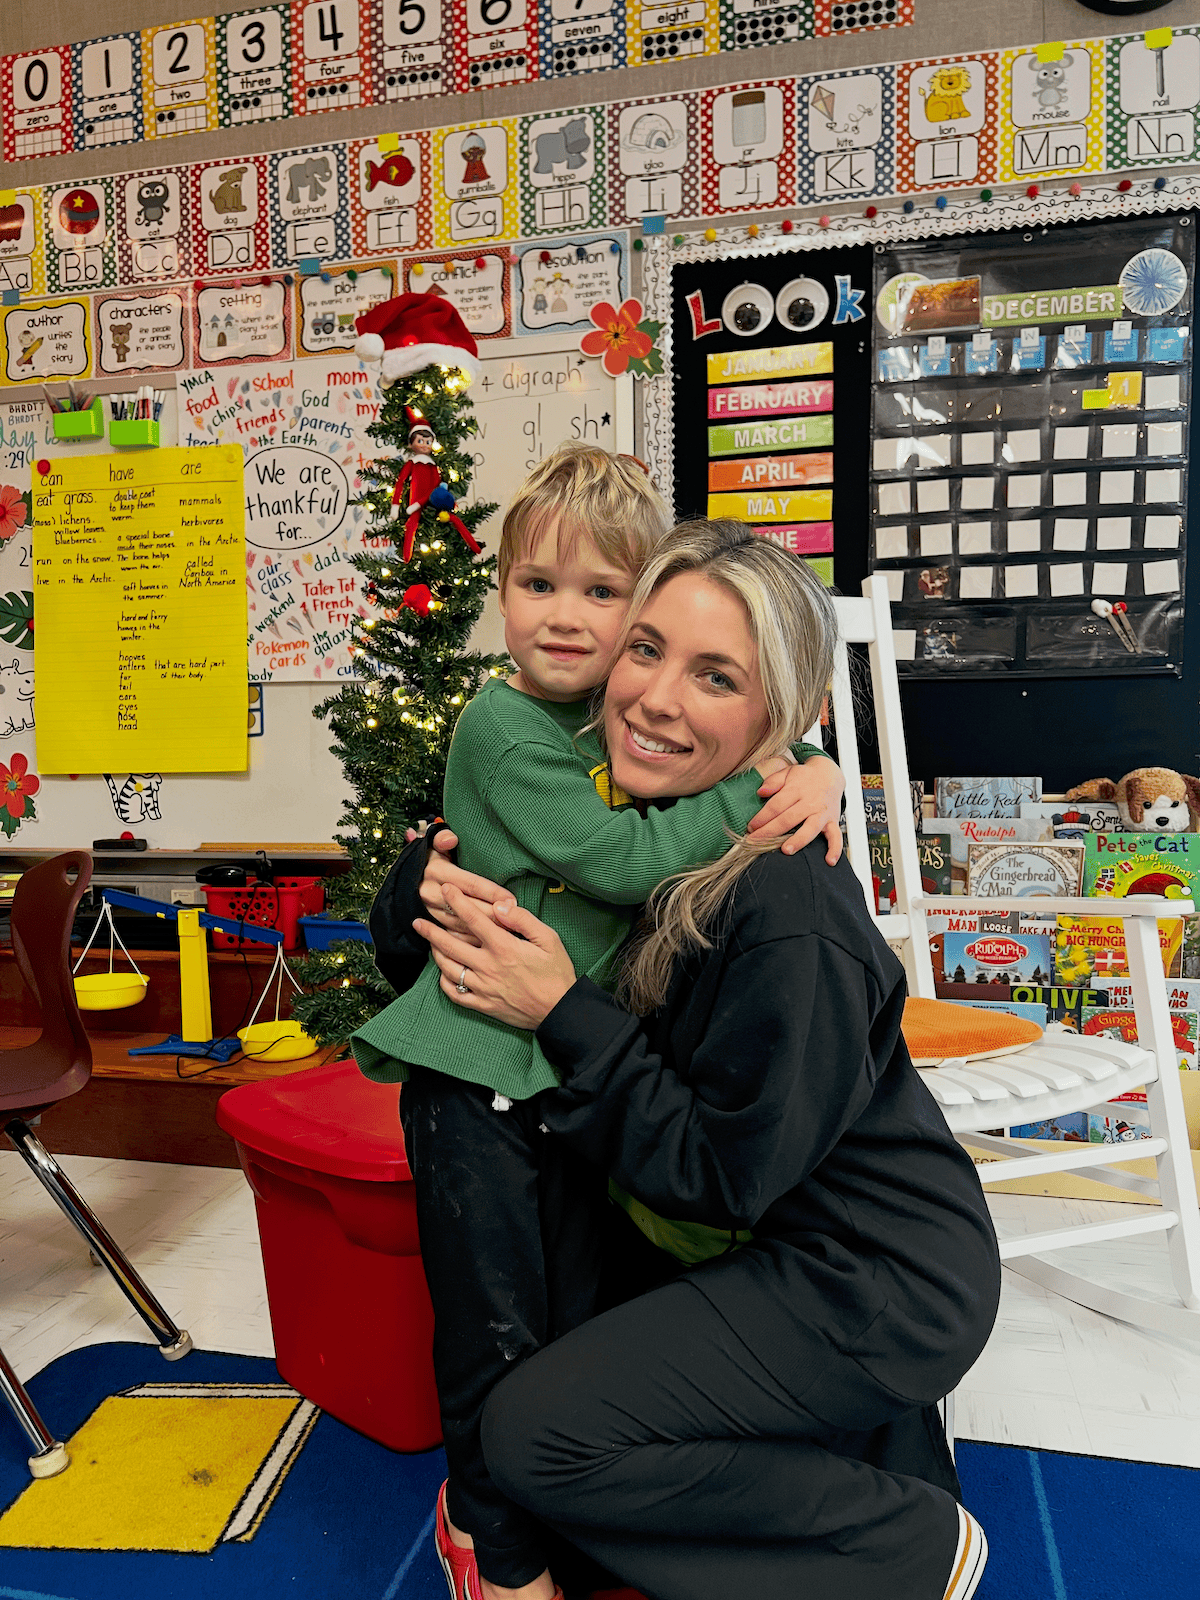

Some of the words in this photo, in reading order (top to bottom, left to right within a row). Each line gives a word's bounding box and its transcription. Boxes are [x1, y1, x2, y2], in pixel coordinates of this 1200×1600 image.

[398, 0, 425, 35] 5
[657, 8, 691, 26] eight
[318, 5, 344, 52] 4
[565, 25, 601, 38] seven
[241, 21, 266, 63] 3
[489, 39, 505, 50] six
[166, 32, 190, 73] 2
[401, 51, 425, 64] five
[104, 49, 111, 88] 1
[320, 63, 345, 76] four
[24, 59, 48, 101] 0
[240, 75, 272, 87] three
[170, 88, 191, 100] two
[1152, 95, 1170, 107] nail
[99, 102, 117, 113] one
[1032, 110, 1070, 120] mouse
[26, 112, 49, 126] zero
[939, 125, 956, 135] lion
[1137, 119, 1185, 155] Nn
[836, 138, 854, 148] kite
[1020, 132, 1082, 170] Mm
[552, 172, 576, 183] hippo
[824, 154, 866, 191] Kk
[457, 183, 496, 196] gumballs
[735, 165, 761, 205] Jj
[384, 196, 399, 205] fish
[641, 179, 666, 213] Ii
[291, 203, 327, 217] elephant
[542, 190, 585, 225] Hh
[223, 215, 238, 226] dog
[456, 200, 497, 236] Gg
[148, 228, 161, 237] cat
[377, 212, 405, 246] Ff
[294, 223, 329, 258] Ee
[211, 234, 251, 266] Dd
[135, 244, 174, 273] Cc
[65, 253, 98, 283] Bb
[334, 281, 357, 296] plot
[220, 293, 262, 307] setting
[991, 292, 1115, 321] DECEMBER
[110, 304, 172, 320] characters
[27, 315, 63, 328] author
[48, 331, 72, 340] writes
[51, 355, 73, 364] story
[721, 352, 817, 376] JANUARY
[180, 370, 214, 394] YMCA
[252, 369, 294, 392] school
[327, 372, 368, 386] mom
[503, 356, 581, 396] digraph
[185, 387, 220, 416] food
[302, 389, 330, 408] God
[715, 387, 823, 412] FEBRUARY
[236, 409, 286, 434] friends
[299, 416, 354, 439] parents
[258, 433, 274, 446] the
[282, 431, 318, 446] Earth
[734, 424, 807, 448] MARCH
[109, 463, 134, 483] have
[180, 462, 202, 476] are
[255, 459, 285, 485] We
[299, 466, 331, 485] are
[741, 462, 800, 483] APRIL
[41, 474, 62, 486] can
[37, 489, 55, 506] eat
[179, 494, 222, 506] mammals
[245, 488, 339, 521] thankful
[109, 502, 116, 512] to
[120, 500, 134, 513] keep
[138, 500, 155, 510] them
[747, 498, 790, 516] MAY
[181, 515, 224, 526] herbivores
[200, 536, 210, 546] the
[77, 553, 89, 564] the
[187, 555, 214, 569] called
[314, 546, 341, 571] dad
[220, 567, 228, 575] in
[257, 562, 281, 581] our
[37, 575, 49, 585] live
[73, 574, 84, 583] the
[179, 578, 202, 588] North
[205, 577, 236, 587] America
[260, 572, 292, 595] class
[302, 579, 335, 597] Tater
[337, 577, 357, 593] Tot
[313, 596, 353, 611] French
[255, 592, 295, 633] weekend
[328, 610, 349, 627] Fry
[313, 630, 329, 645] the
[314, 626, 355, 659] galaxy
[256, 640, 309, 656] Pokemon
[269, 653, 306, 670] cards
[118, 720, 137, 730] head
[955, 792, 989, 808] Little
[994, 793, 1022, 808] Red
[960, 821, 1016, 842] Rudolph
[1097, 836, 1137, 852] Pete
[1155, 836, 1189, 852] Cat
[1006, 858, 1025, 868] The
[990, 867, 1056, 885] Gingerbread
[982, 882, 1013, 896] Man
[983, 922, 1012, 933] LOOSE
[1071, 925, 1103, 934] Merry
[975, 942, 1019, 955] RUDOLPH
[1066, 935, 1085, 946] BIG
[1088, 936, 1126, 946] HUNGR
[1171, 989, 1189, 1000] AN
